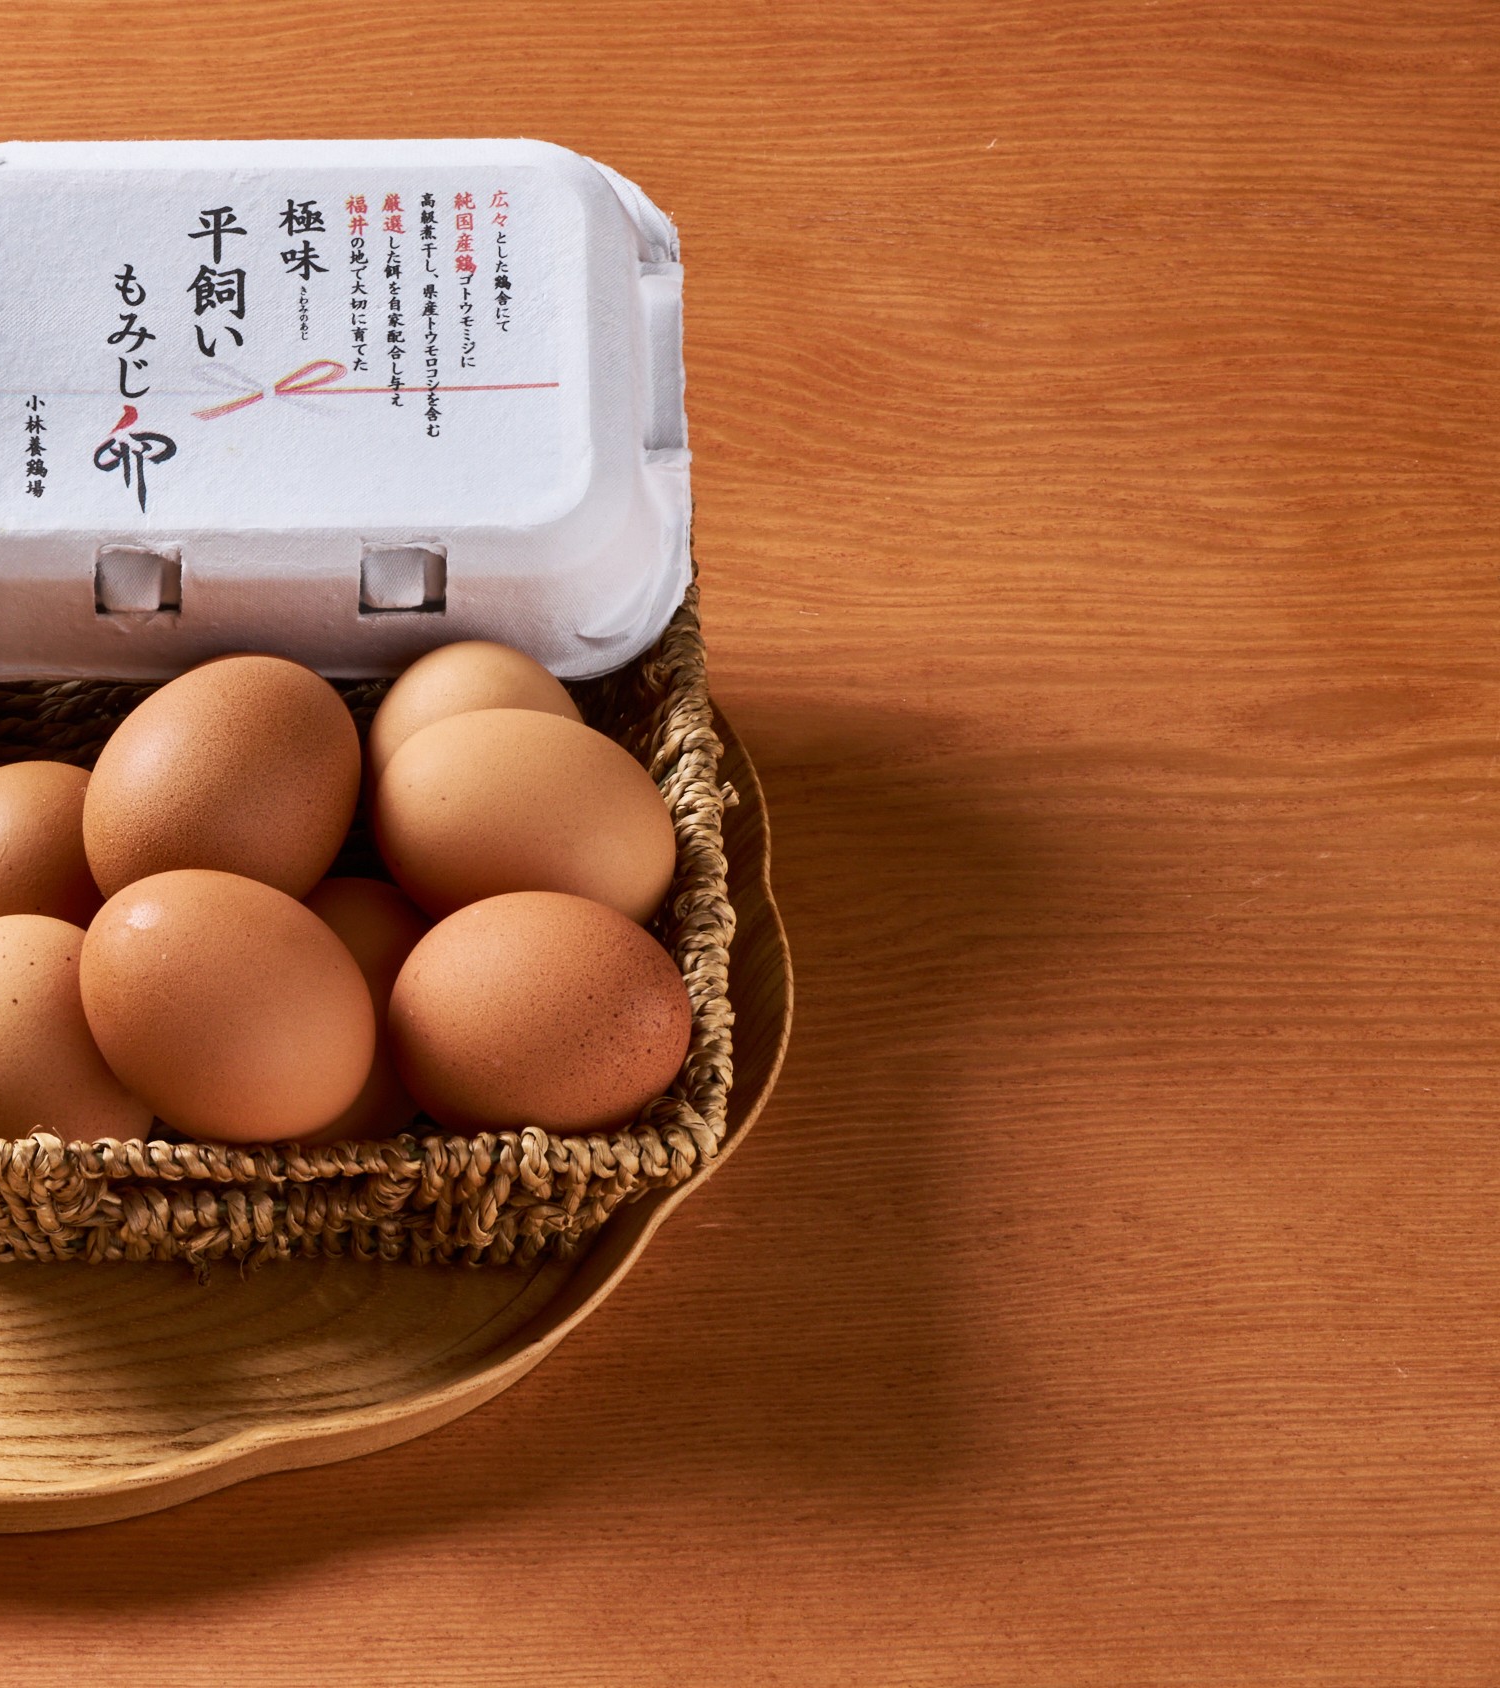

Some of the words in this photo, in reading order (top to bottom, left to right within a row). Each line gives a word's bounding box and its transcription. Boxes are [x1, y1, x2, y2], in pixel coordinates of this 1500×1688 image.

[186, 205, 247, 358] 平飼い
[279, 199, 329, 281] 極味
[298, 285, 309, 341] きわみのあじ
[345, 195, 369, 372] 福井の地で大切に育てた
[381, 193, 406, 407] 厳選した餌を自家配合し与え
[420, 193, 442, 438] 高級煮干し、県産トウモロコシを含む
[454, 191, 477, 368] 純国産鶏ゴトウモミジに
[489, 190, 513, 332] 広々とした鶏舎にて
[24, 395, 48, 498] 小林養鶏場
